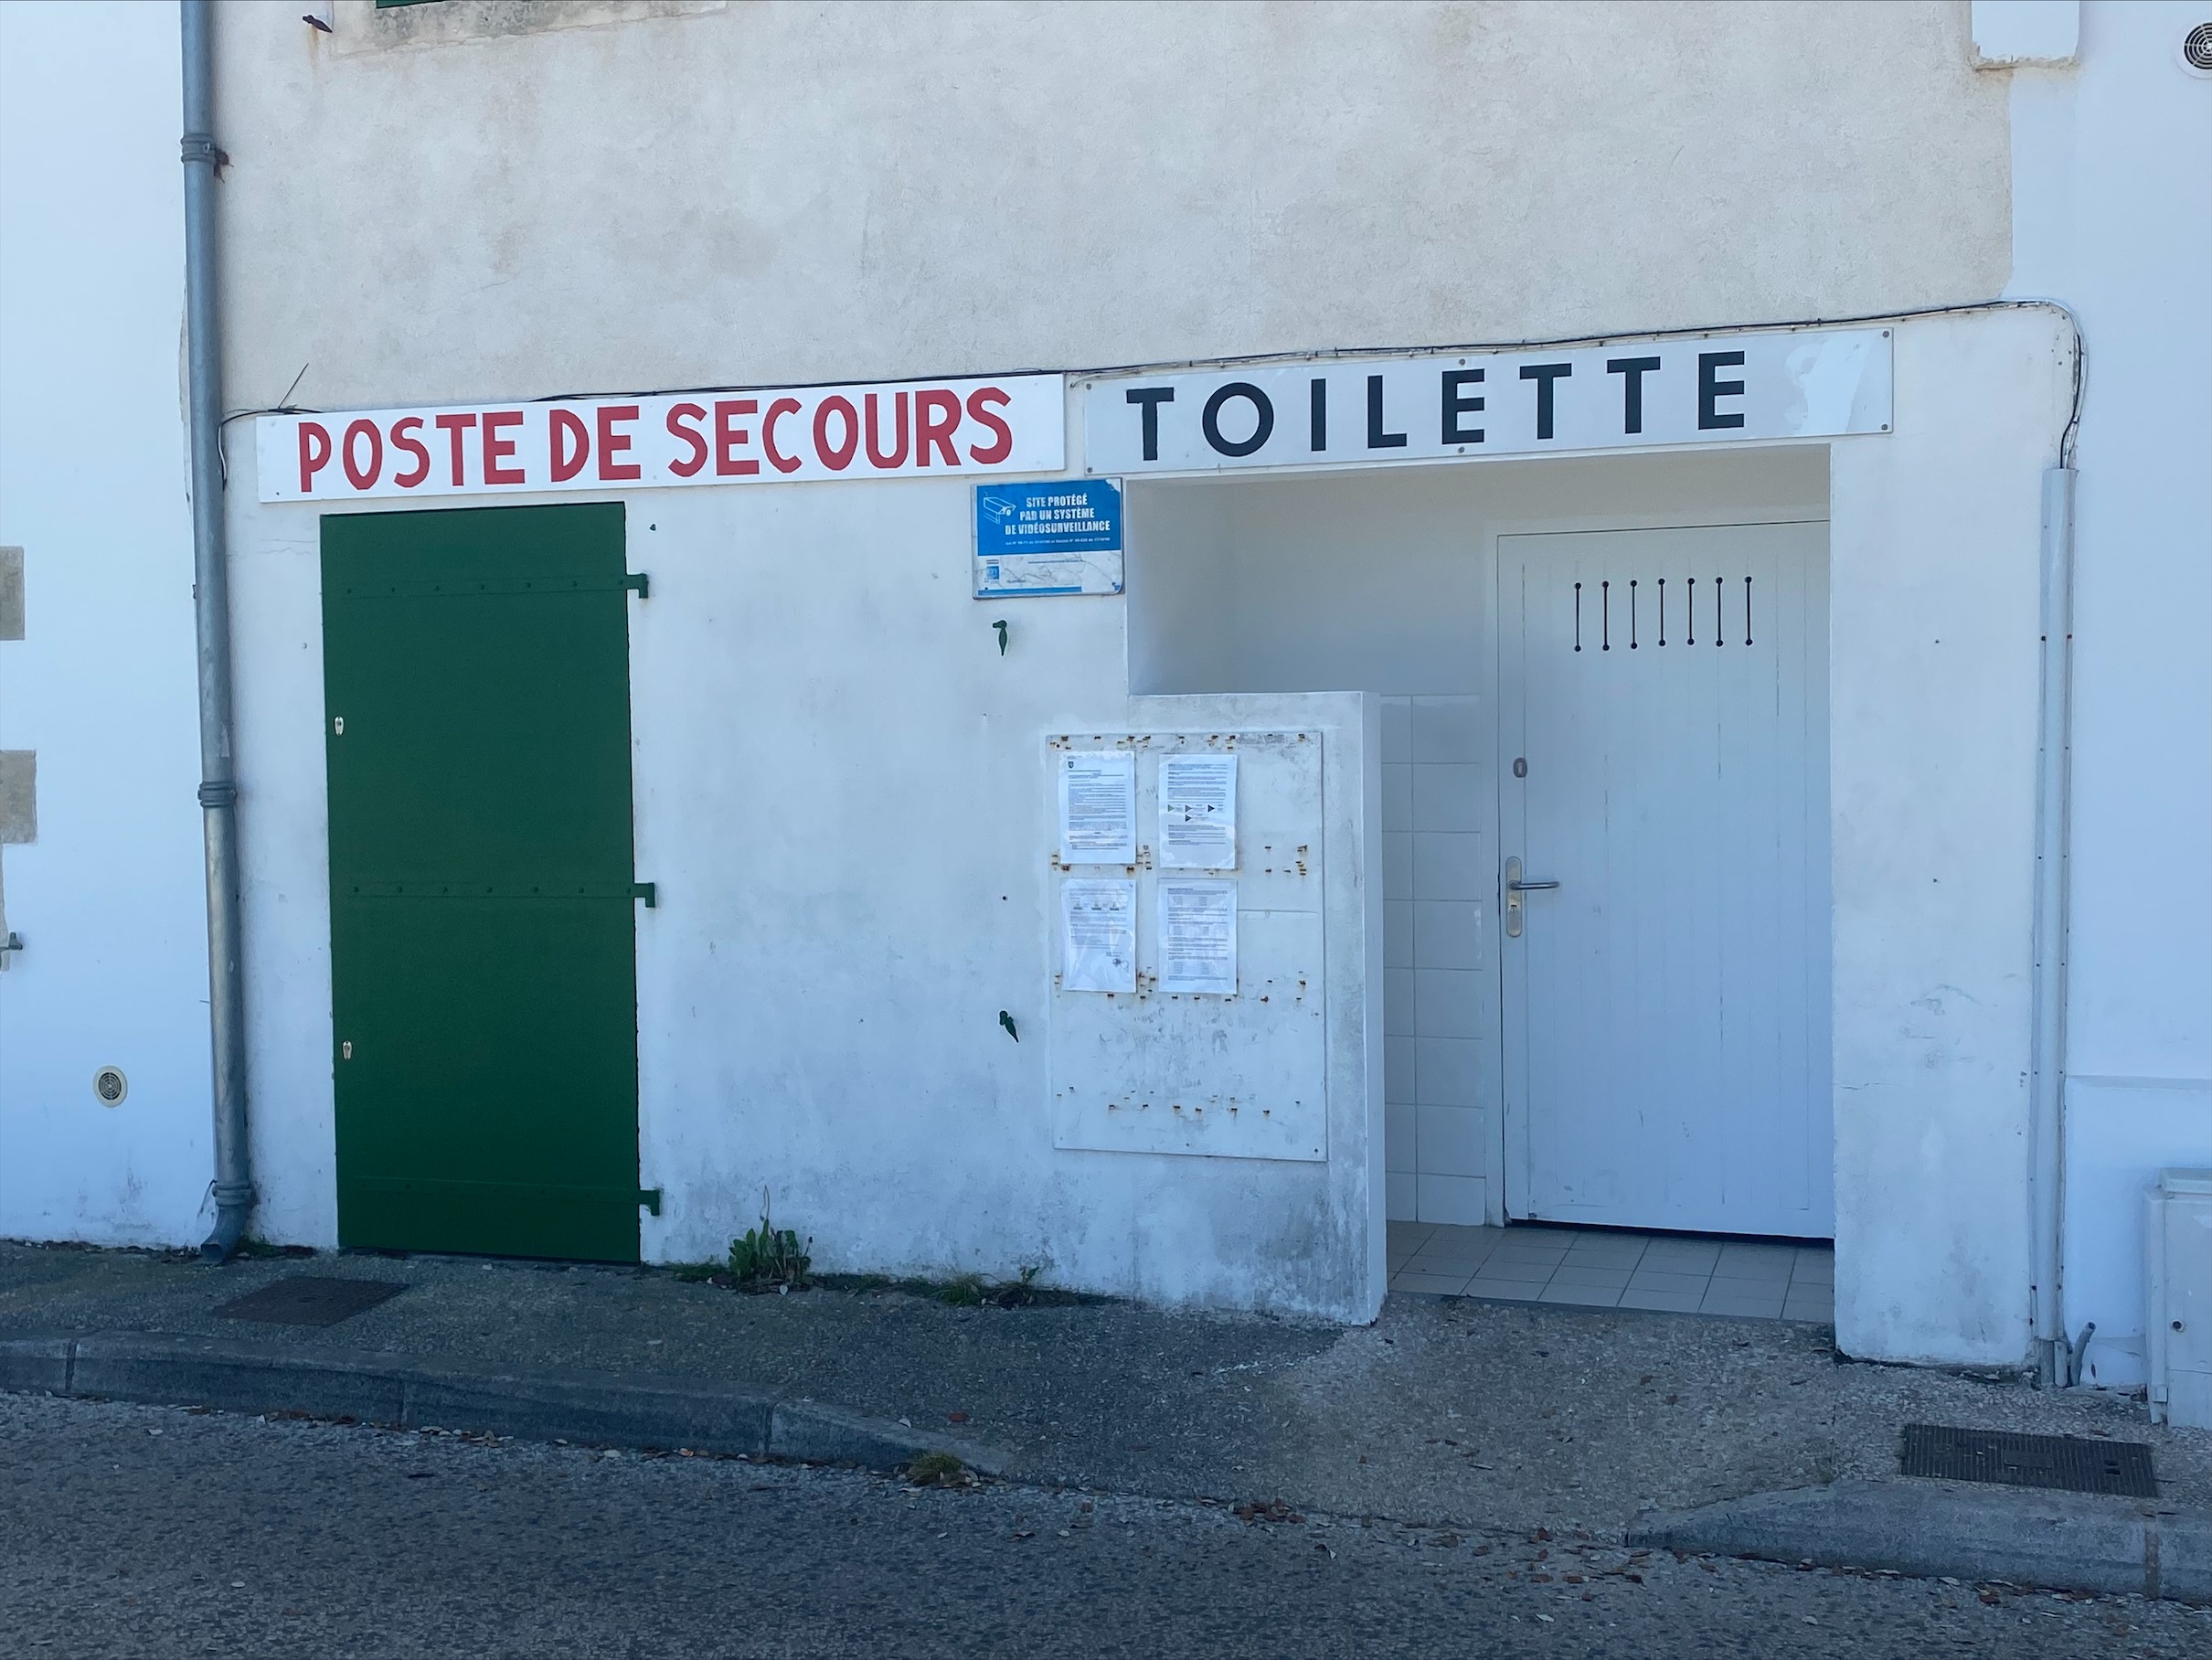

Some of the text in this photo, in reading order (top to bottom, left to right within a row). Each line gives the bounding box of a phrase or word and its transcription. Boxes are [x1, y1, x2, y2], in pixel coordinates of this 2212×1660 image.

[1126, 350, 1745, 461] TOILETTE
[298, 388, 1012, 493] POSTE DE SECOURS
[1026, 493, 1088, 507] SITE PROTÉGÉ
[1019, 507, 1095, 521] PAR UN SYSTÈME
[1005, 521, 1111, 535] DE VIDÉOSURVEILLANCE
